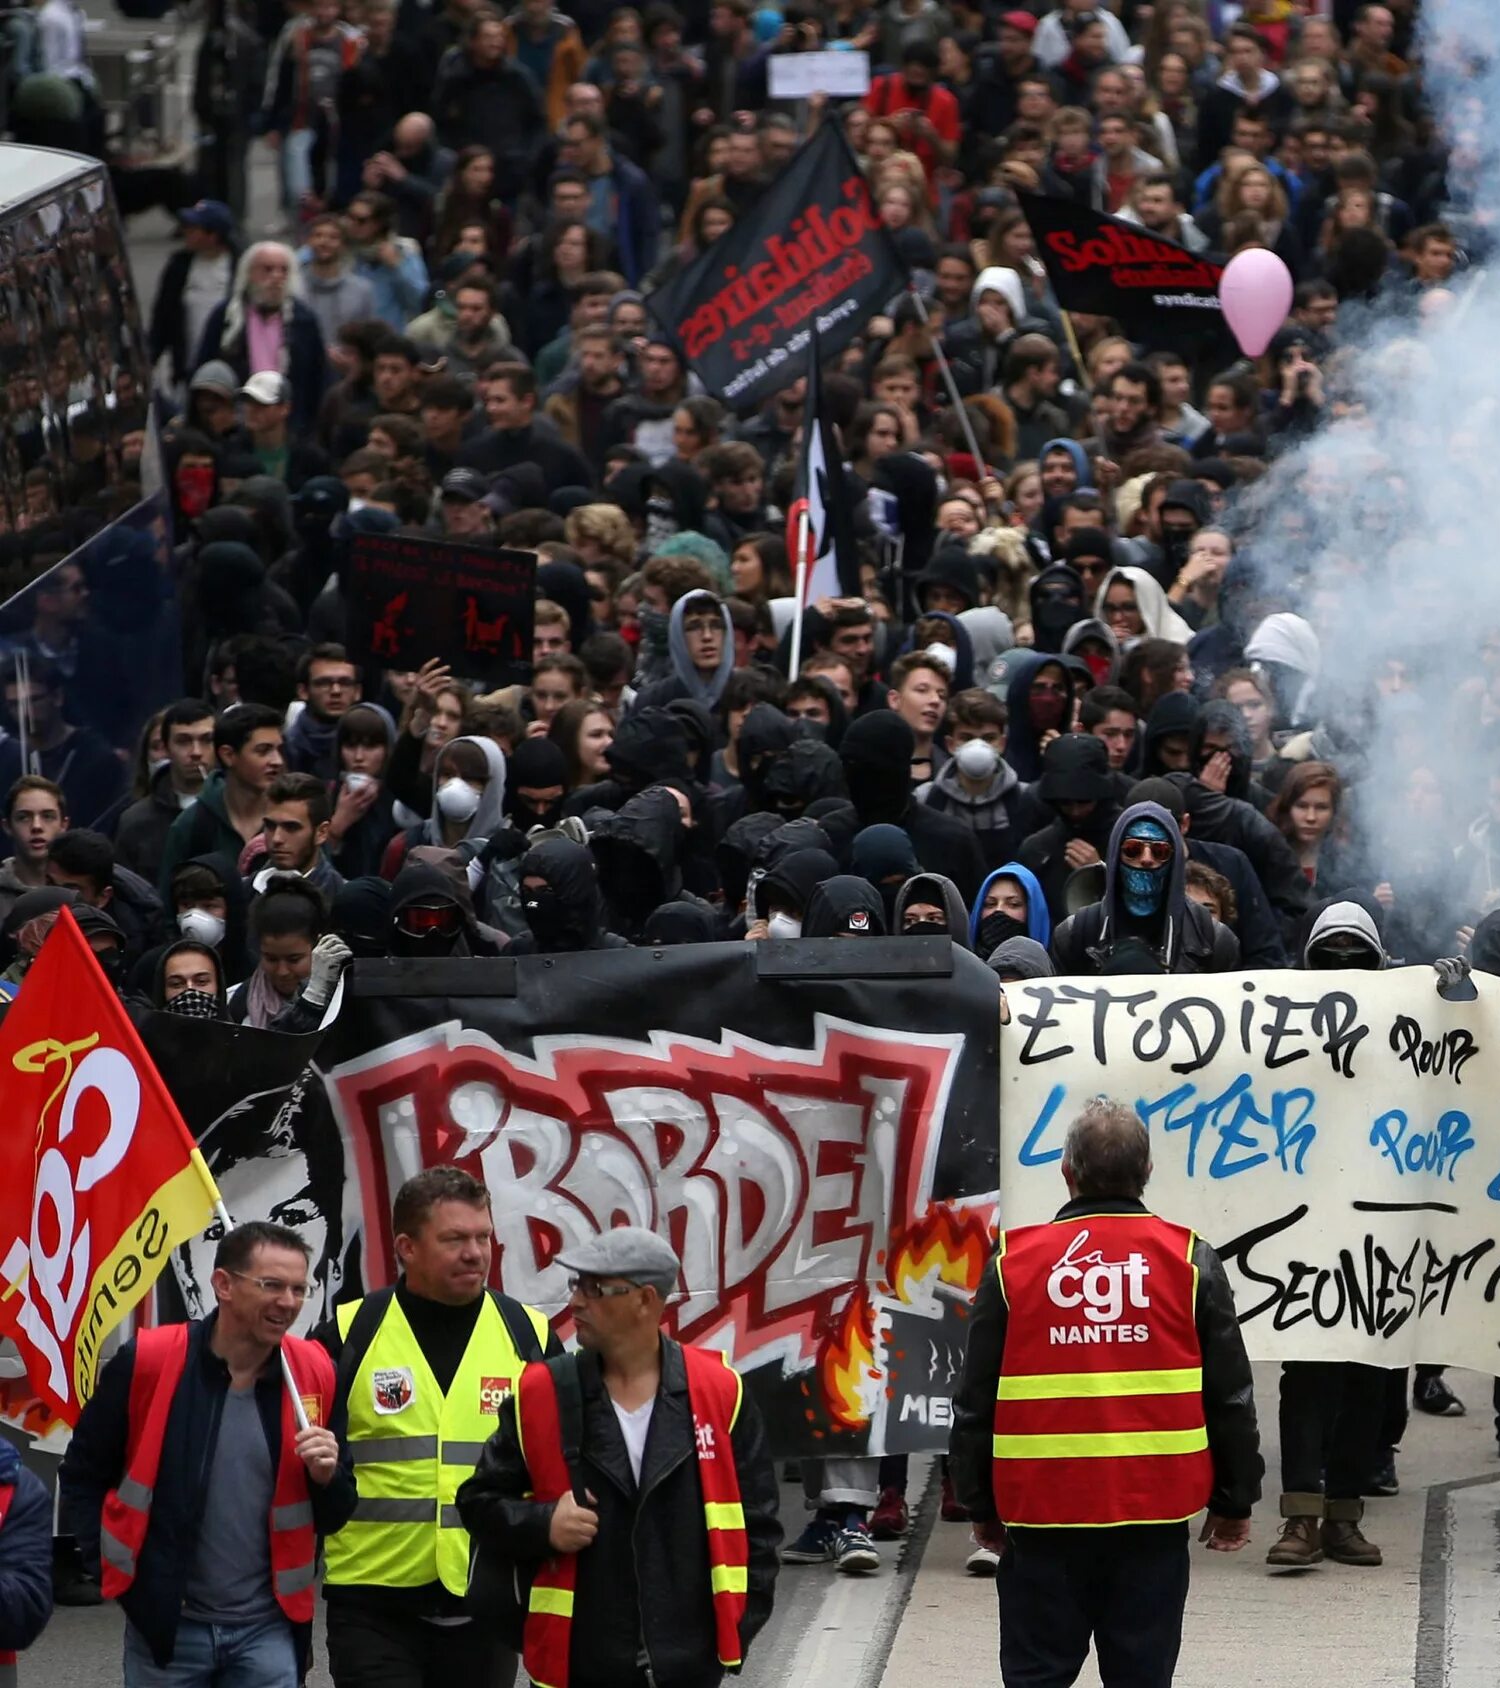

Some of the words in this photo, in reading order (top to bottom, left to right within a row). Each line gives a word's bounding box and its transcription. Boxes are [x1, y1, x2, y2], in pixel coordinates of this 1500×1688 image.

[1047, 1253, 1150, 1323] cgt
[1050, 1324, 1149, 1345] NANTES
[899, 1394, 954, 1429] ME
